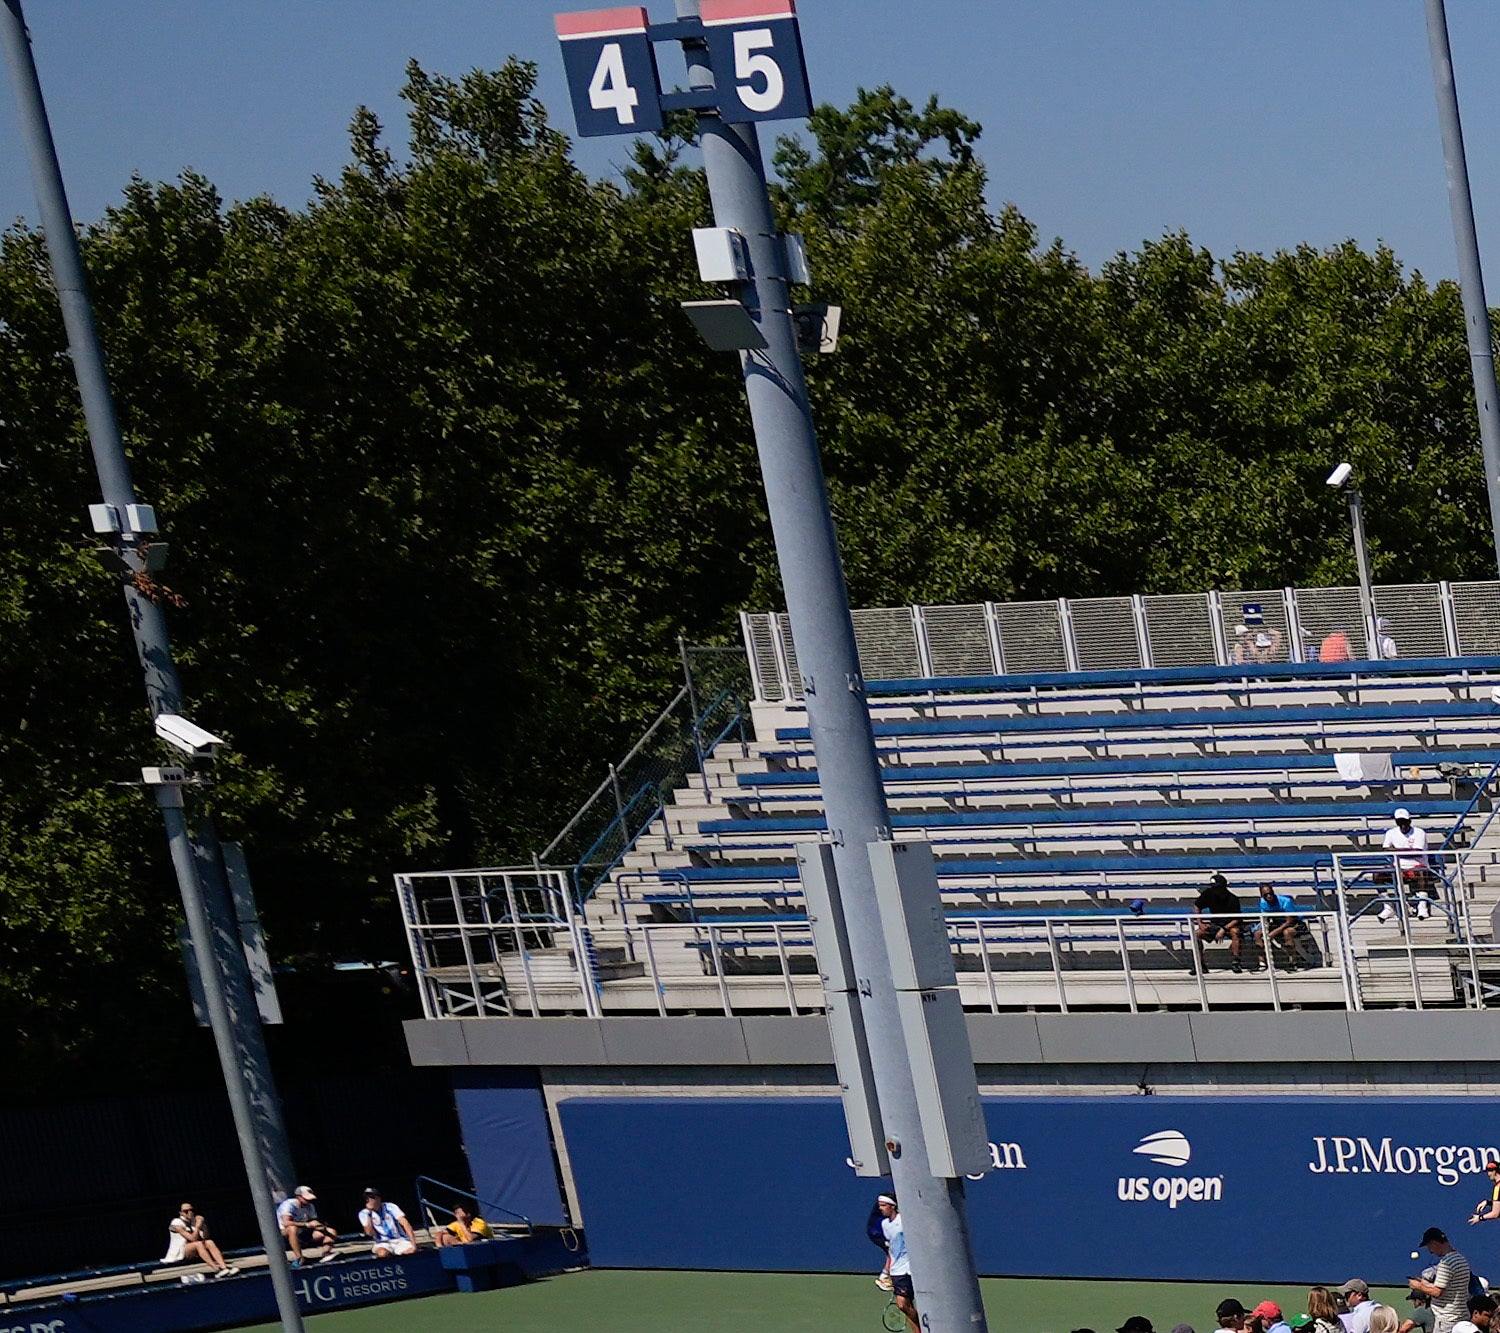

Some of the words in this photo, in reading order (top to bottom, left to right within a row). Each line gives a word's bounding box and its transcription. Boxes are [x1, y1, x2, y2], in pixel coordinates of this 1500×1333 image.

[588, 43, 639, 125] 4
[732, 28, 784, 112] 5
[1309, 1136, 1500, 1185] J.P.Morgan
[1118, 1177, 1150, 1201] us
[1153, 1175, 1221, 1208] open
[340, 1266, 393, 1283] HOTELS
[395, 1264, 404, 1276] &
[343, 1278, 408, 1298] RESORTS
